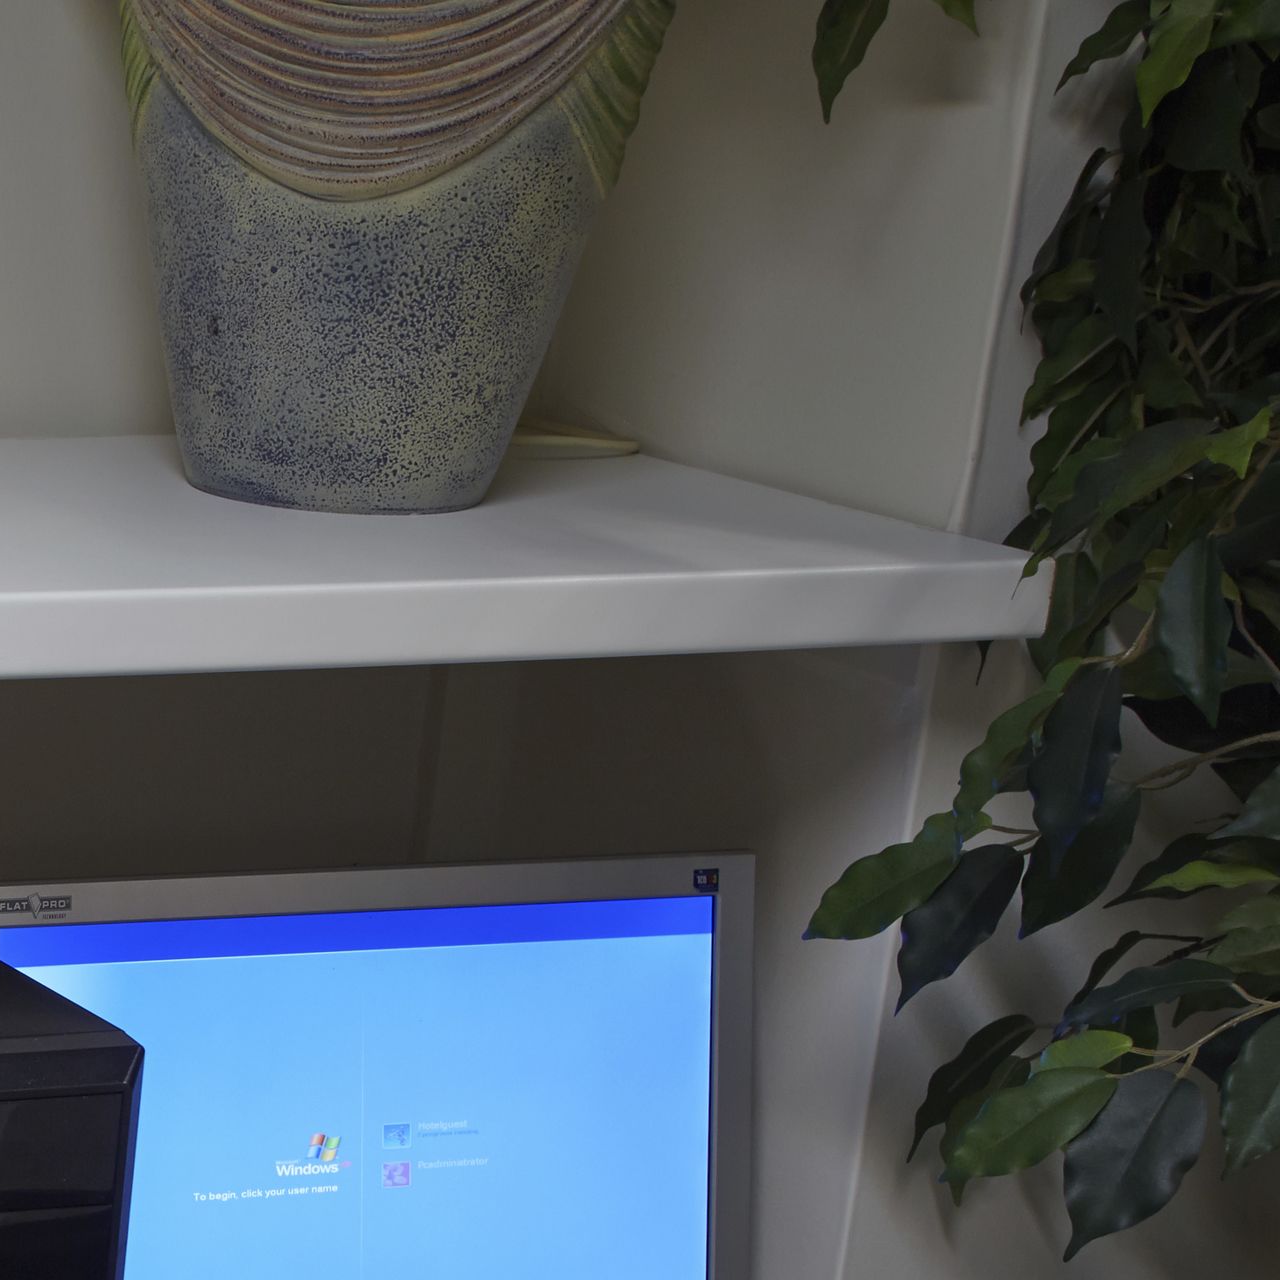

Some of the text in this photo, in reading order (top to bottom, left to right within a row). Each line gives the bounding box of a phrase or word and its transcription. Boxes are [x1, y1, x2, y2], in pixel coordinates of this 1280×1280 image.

[0, 899, 67, 911] FLAT PRO
[276, 1163, 340, 1177] Windows
[193, 1185, 338, 1202] To begin, click your user name
